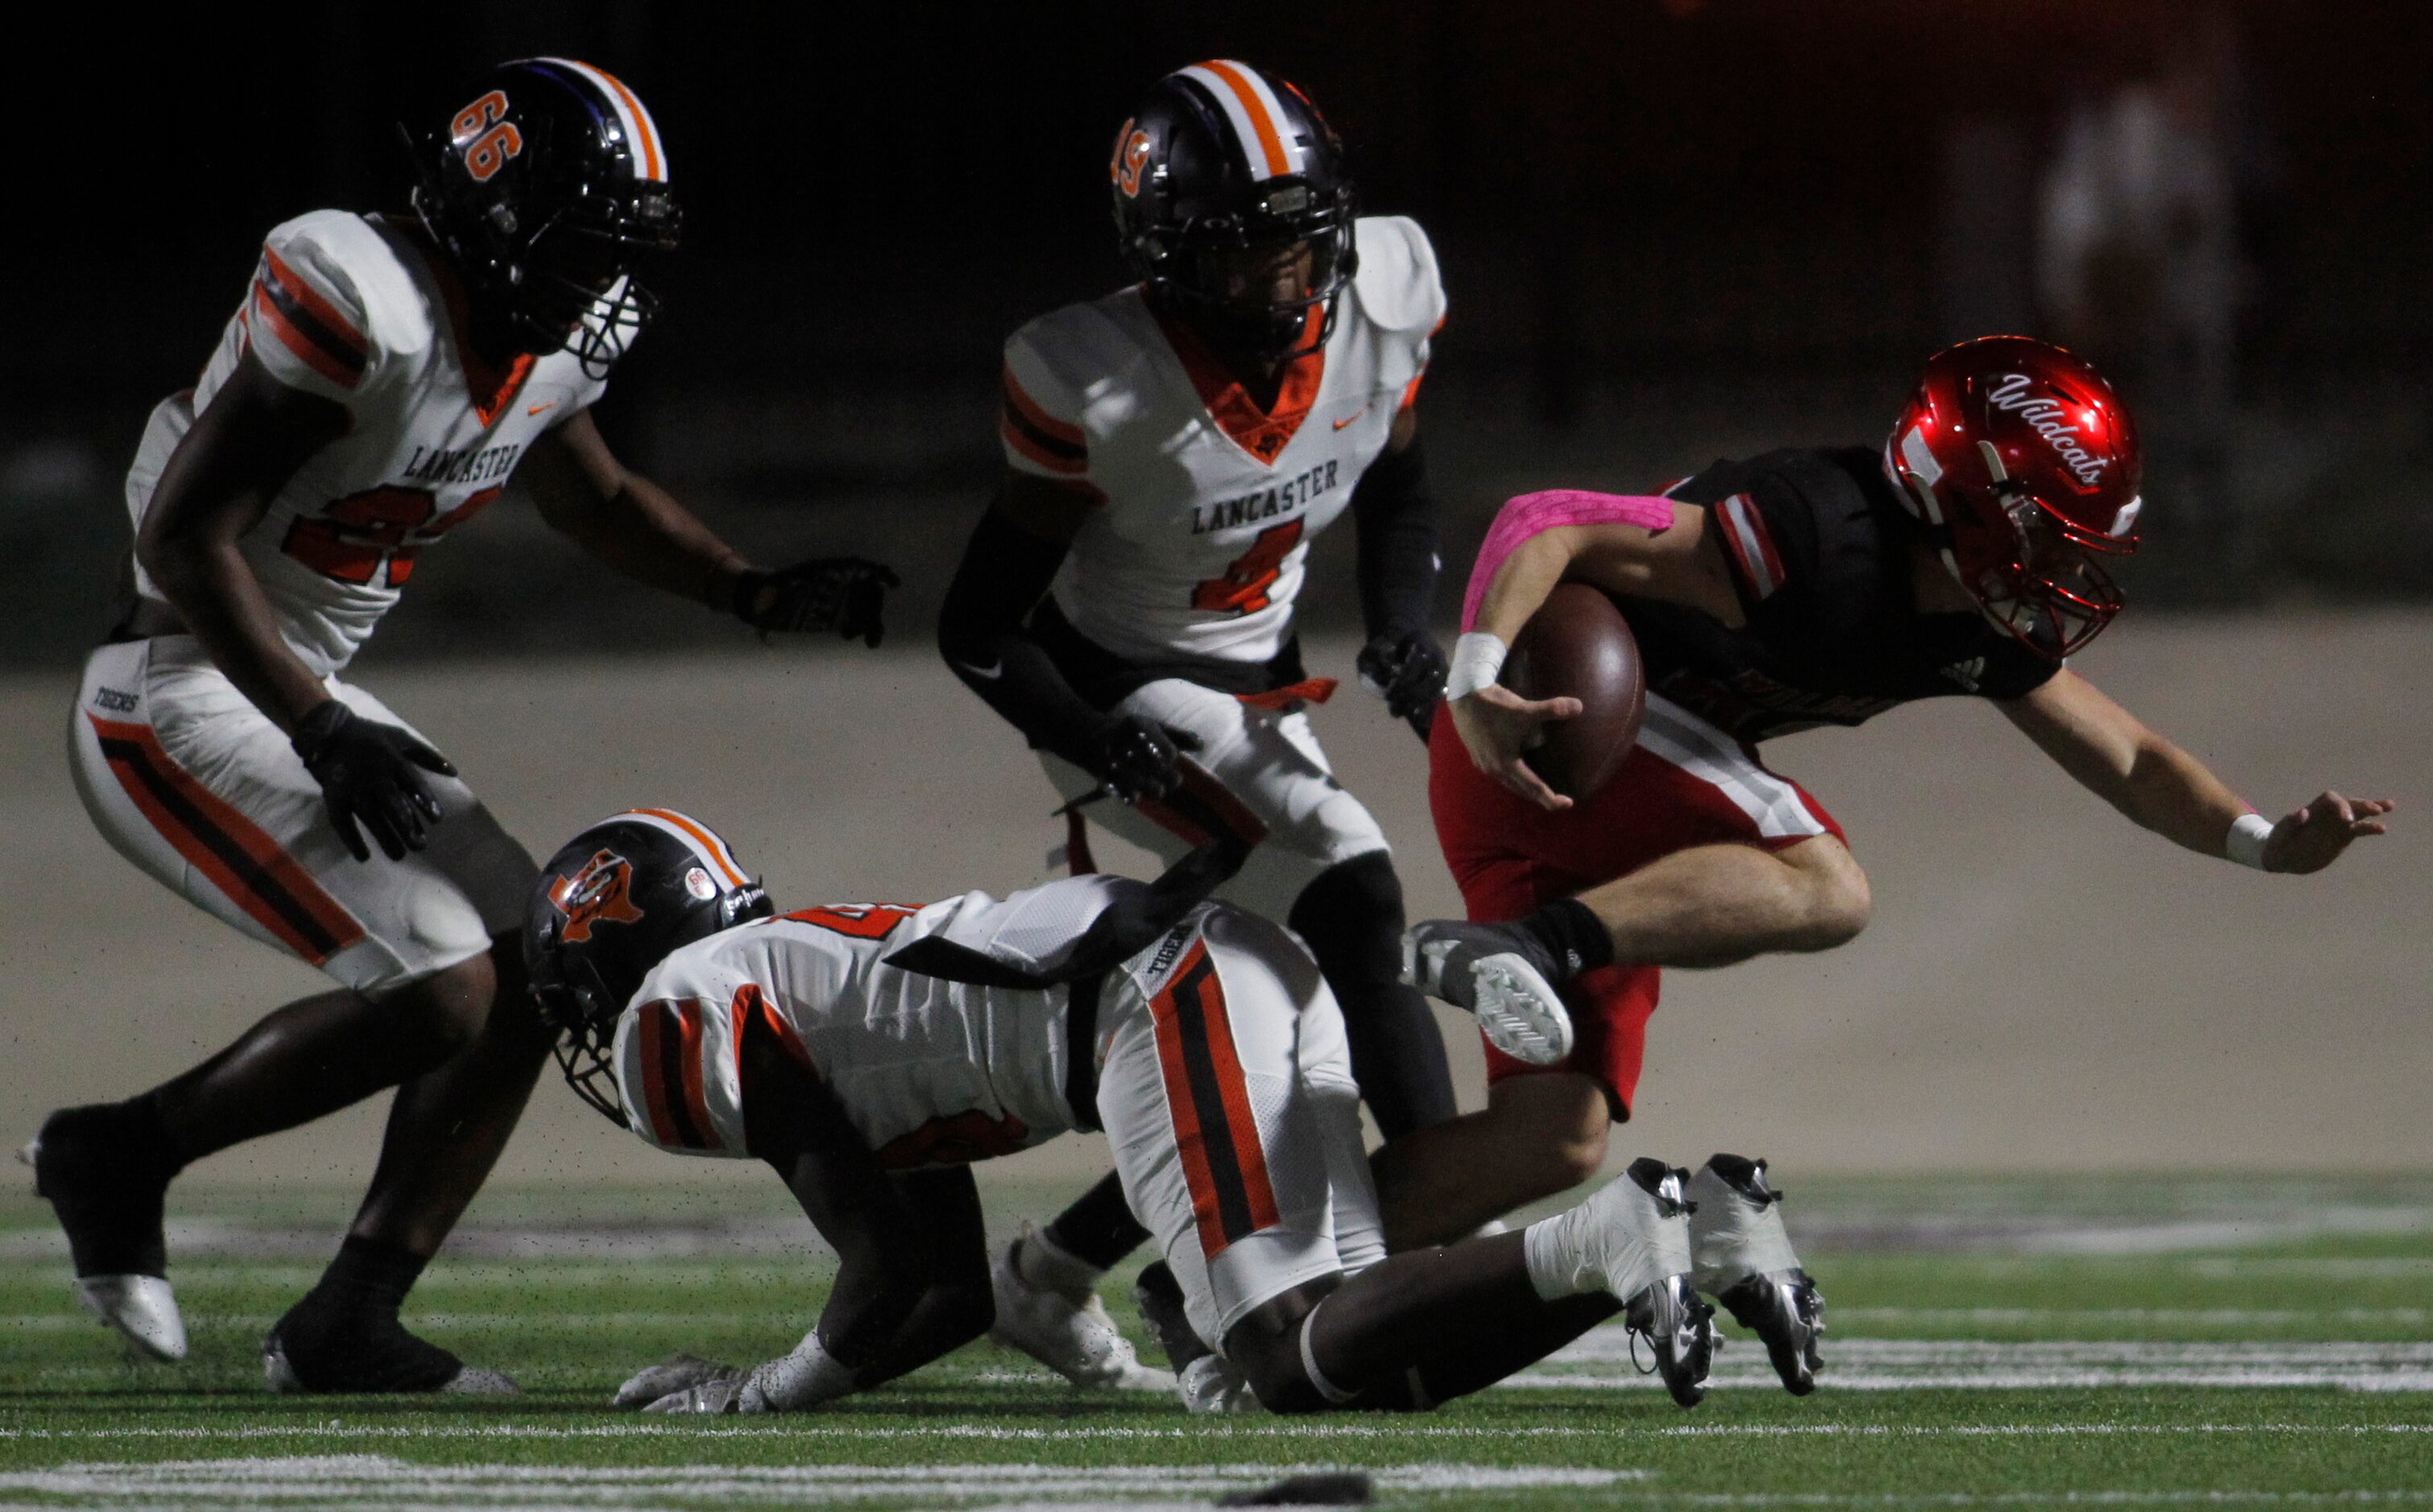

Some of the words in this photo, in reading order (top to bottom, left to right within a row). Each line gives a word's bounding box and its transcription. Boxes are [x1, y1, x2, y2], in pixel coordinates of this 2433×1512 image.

[451, 89, 523, 182] 66
[1989, 374, 2108, 485] Wildcats
[1190, 460, 1338, 535] LANCASTER
[1191, 512, 1305, 614] 4
